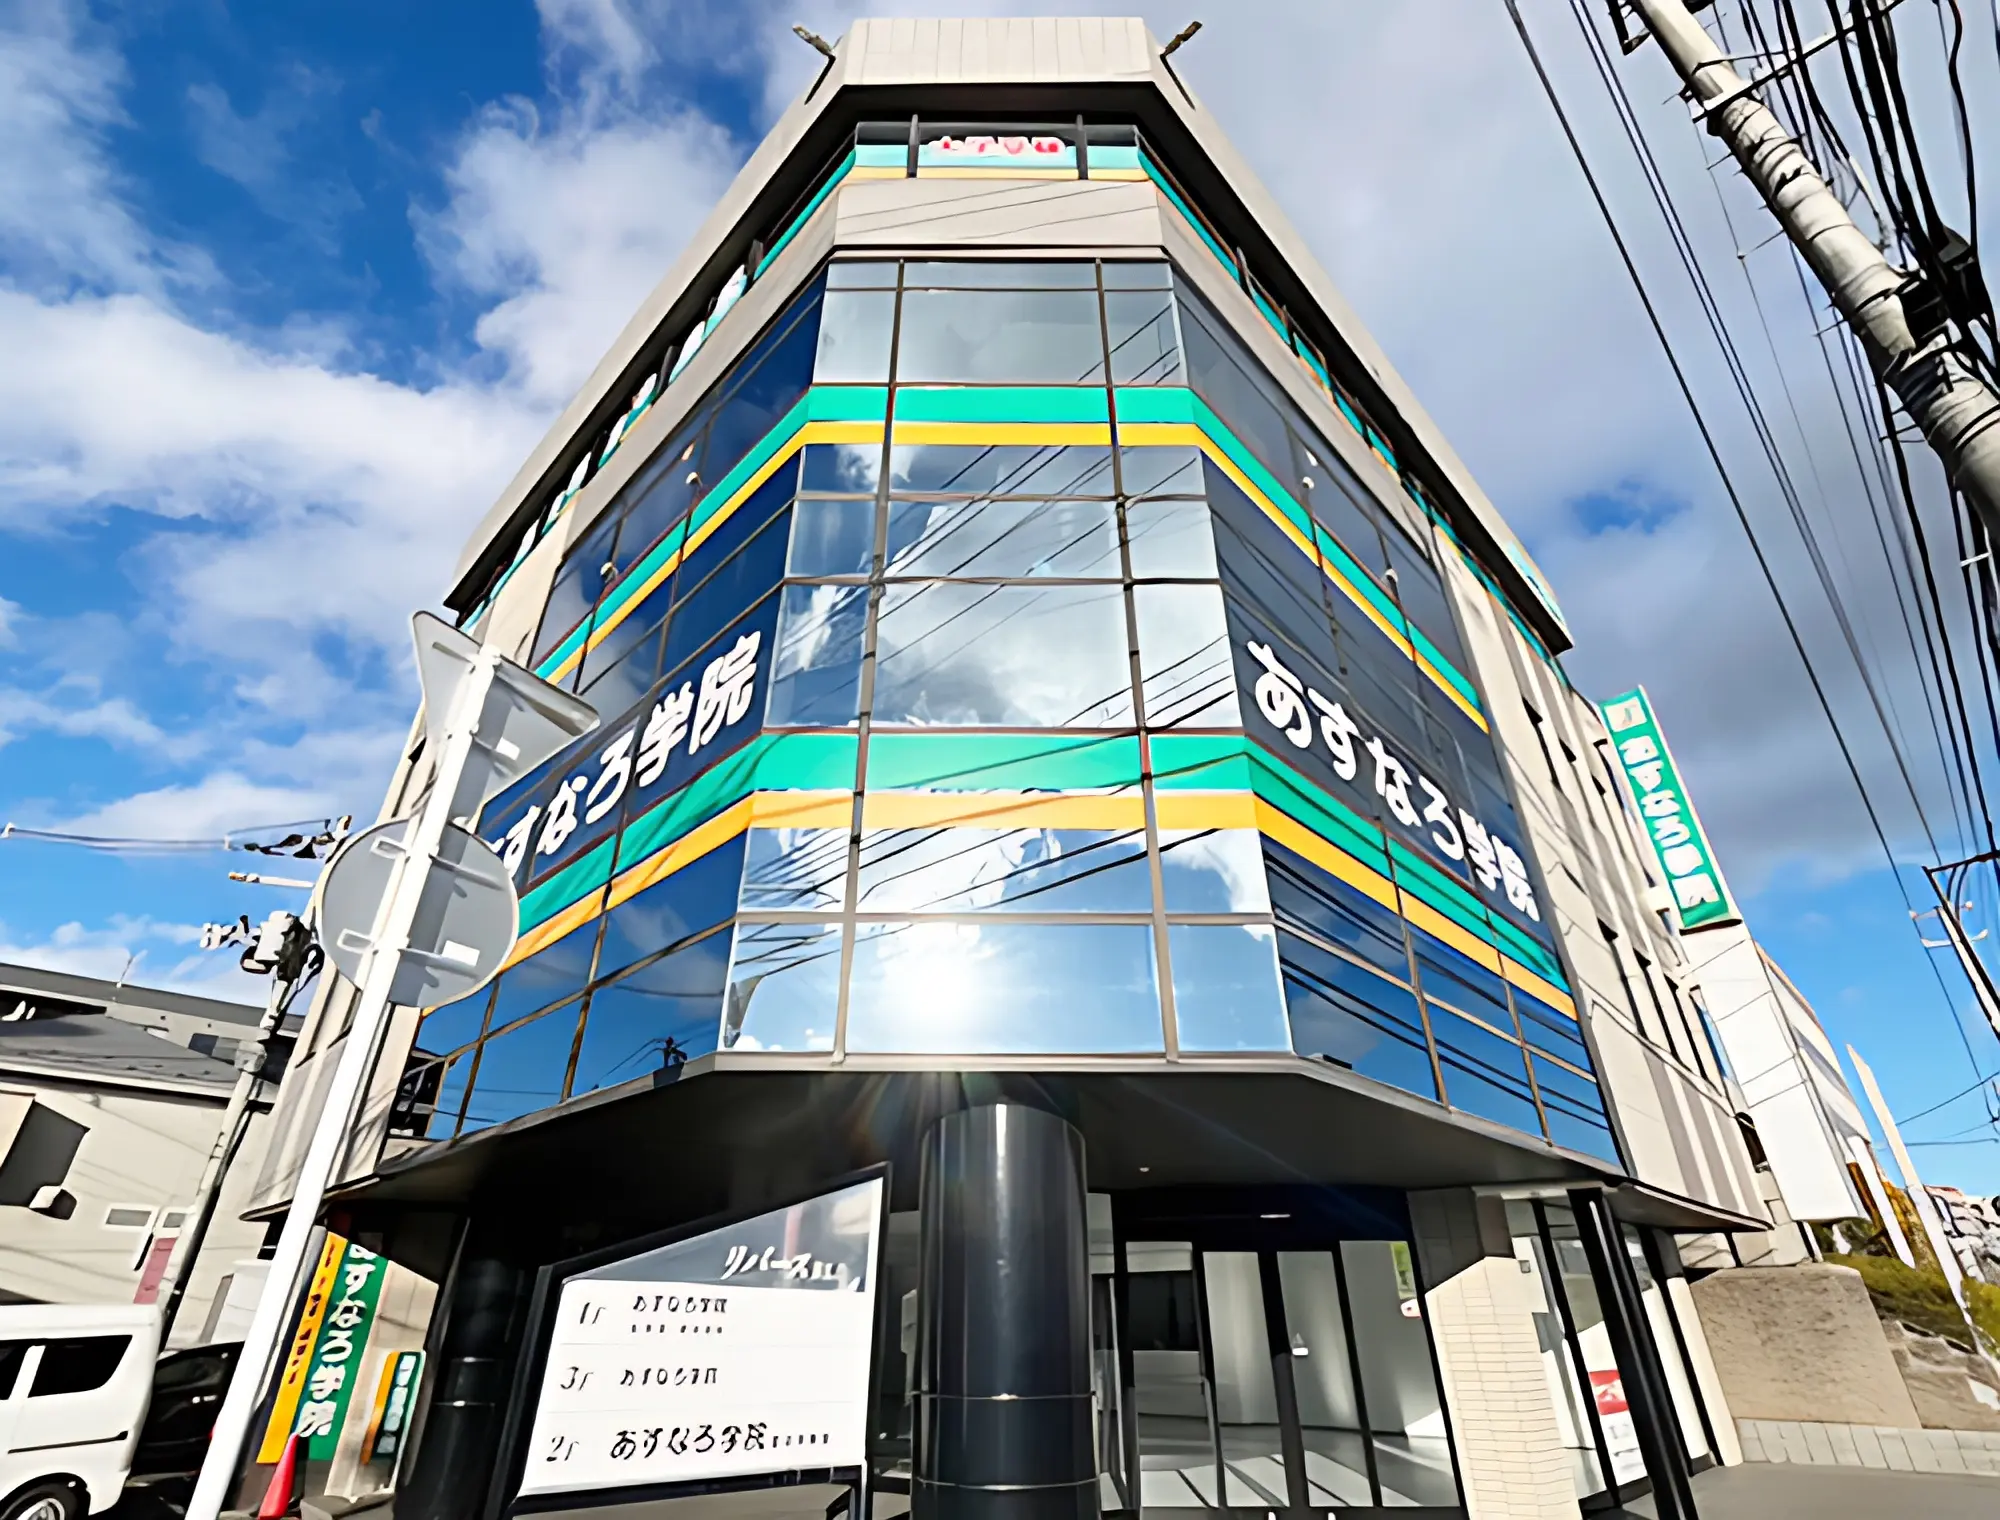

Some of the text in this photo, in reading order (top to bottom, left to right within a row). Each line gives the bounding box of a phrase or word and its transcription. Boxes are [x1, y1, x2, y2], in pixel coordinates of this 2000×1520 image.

[1247, 640, 1541, 922] あすなろ学院
